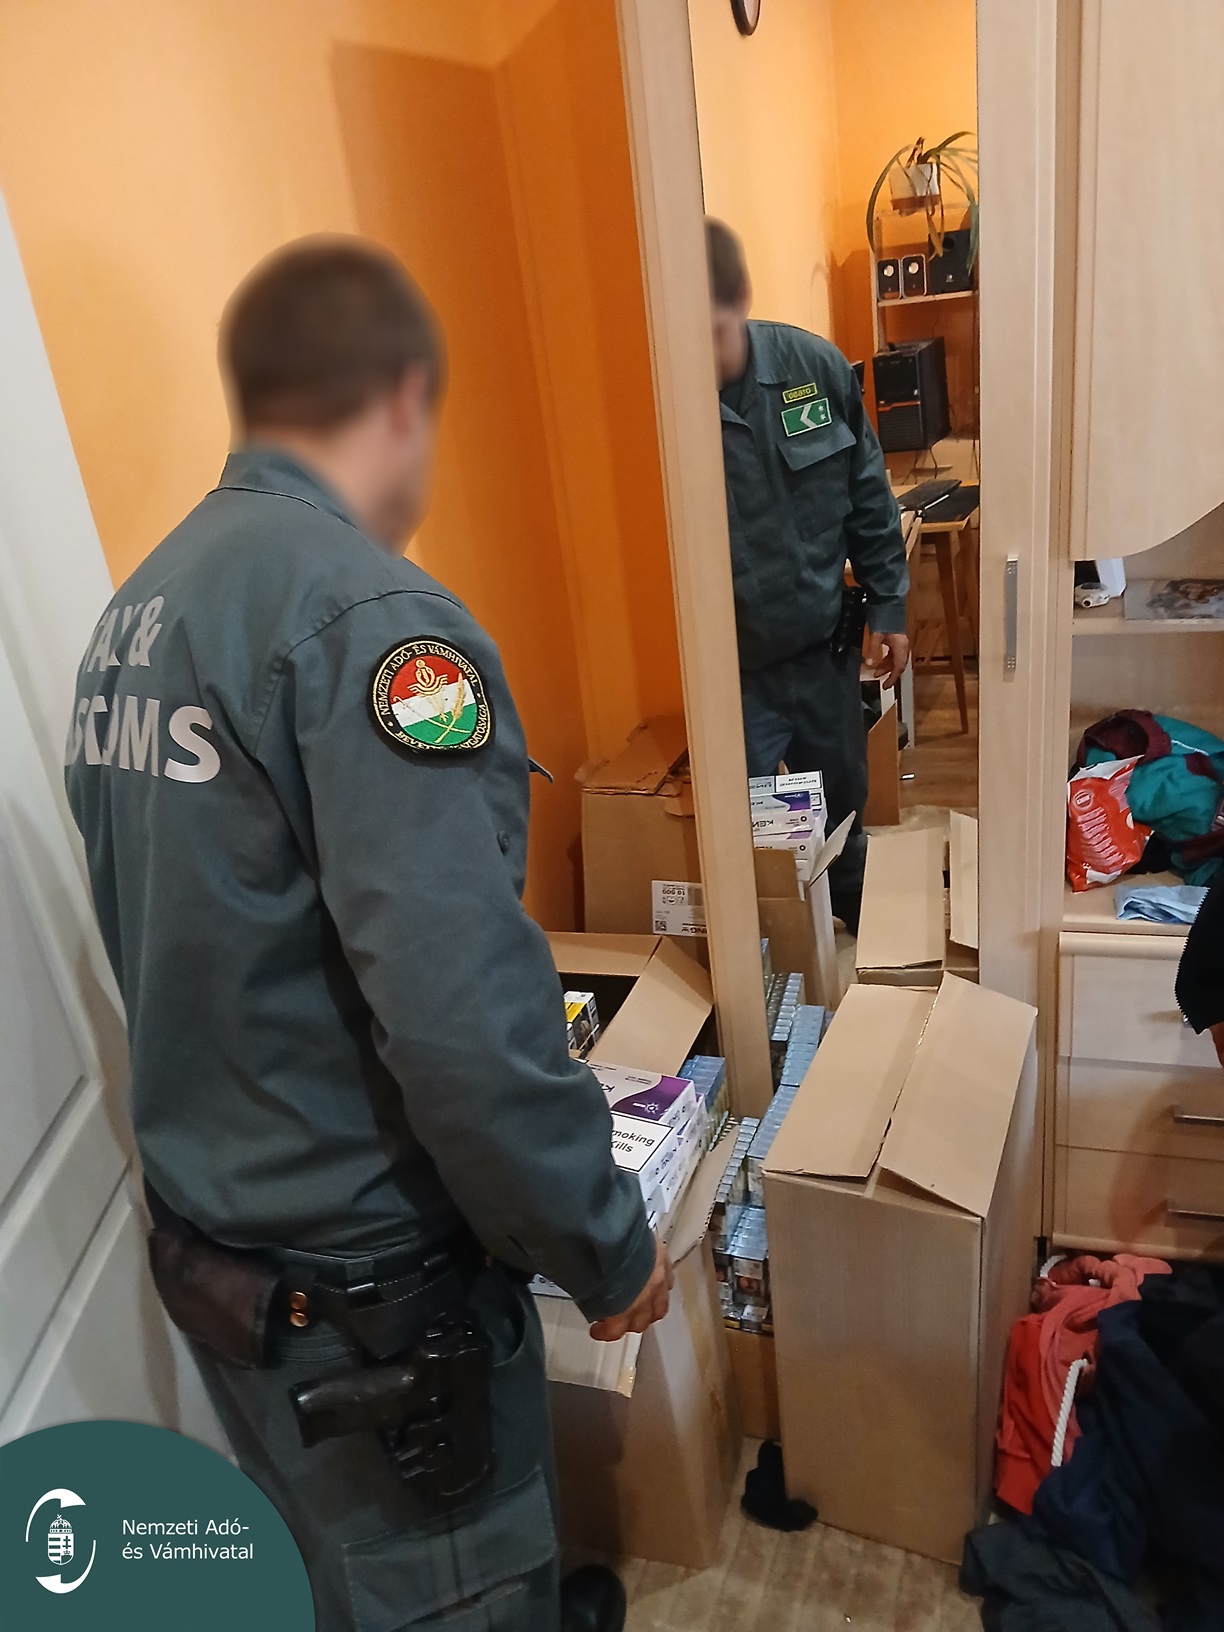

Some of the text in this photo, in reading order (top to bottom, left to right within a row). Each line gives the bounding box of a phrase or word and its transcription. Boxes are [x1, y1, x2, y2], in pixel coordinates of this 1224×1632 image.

[128, 596, 164, 667] &
[378, 669, 394, 716] NEMZETI
[412, 644, 427, 655] ÉS
[611, 1130, 655, 1147] moking
